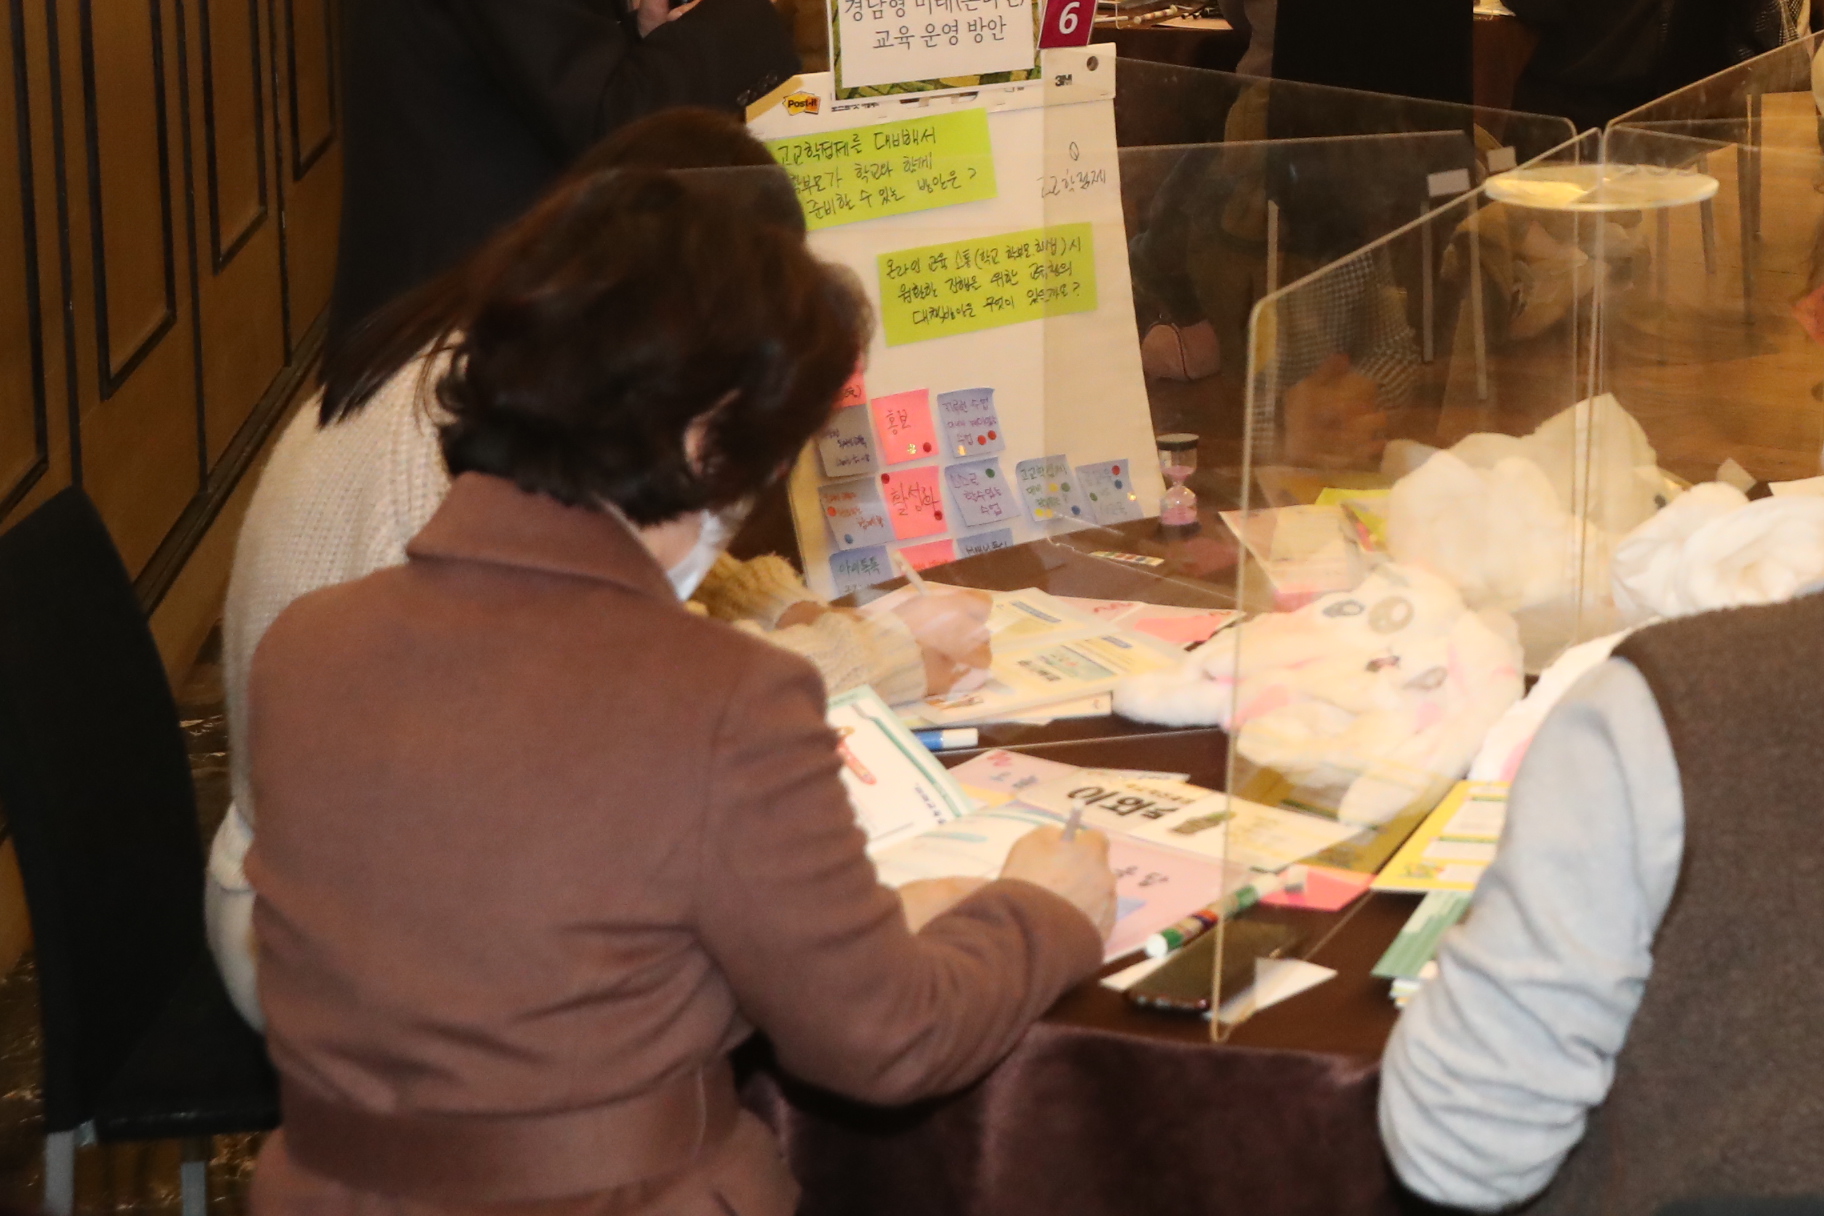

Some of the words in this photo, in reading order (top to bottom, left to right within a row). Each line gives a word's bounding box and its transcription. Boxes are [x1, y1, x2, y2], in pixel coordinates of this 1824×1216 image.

[873, 26, 915, 50] 교육
[920, 19, 959, 48] 운영
[967, 15, 1007, 44] 방안
[1058, 2, 1079, 34] 6
[1055, 74, 1073, 86] 3M
[777, 134, 863, 166] 고교학점제를
[874, 128, 936, 150] 대비해서
[855, 161, 893, 184] 학교와
[902, 151, 933, 173] 함께
[806, 192, 855, 220] 준비할
[859, 189, 873, 206] 수
[878, 186, 905, 206] 있는
[917, 170, 962, 194] 방안은
[886, 257, 921, 278] 온라인
[928, 253, 948, 272] 교육
[990, 269, 1019, 288] 위한
[983, 295, 1015, 313] 무엇이
